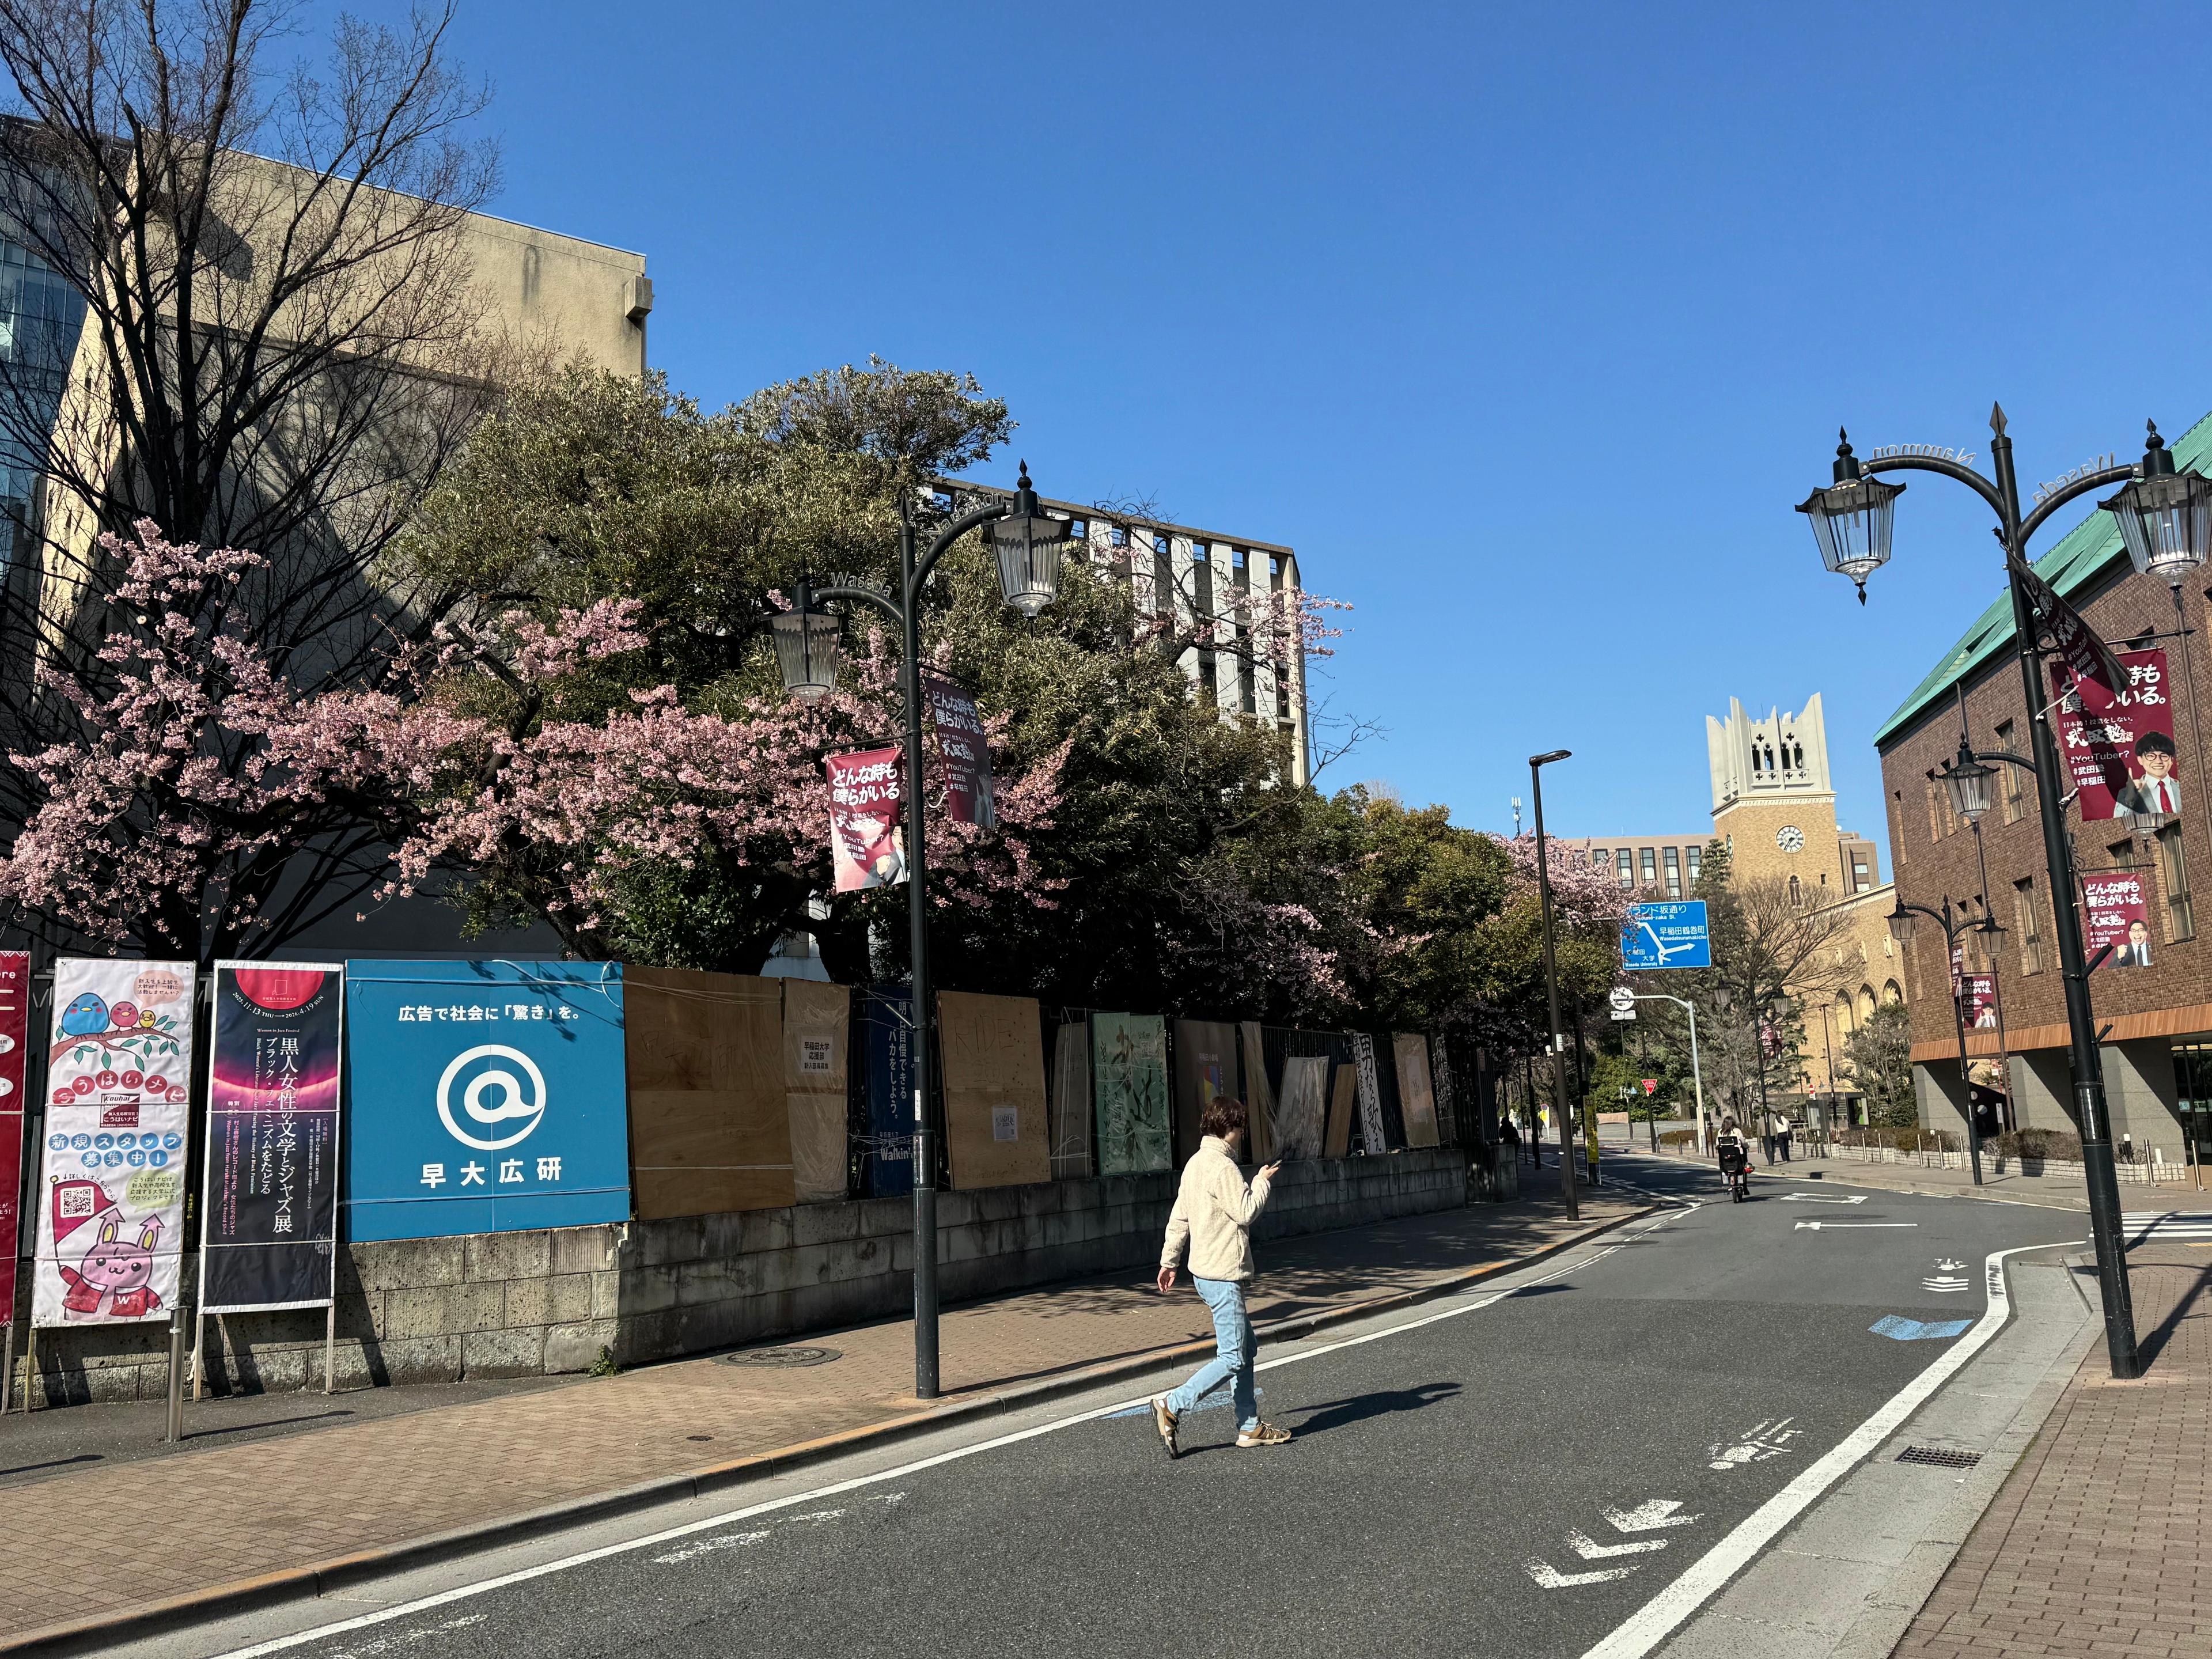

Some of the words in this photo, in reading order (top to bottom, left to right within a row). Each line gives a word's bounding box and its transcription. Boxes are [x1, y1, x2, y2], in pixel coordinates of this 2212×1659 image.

[830, 570, 892, 599] Waseda
[932, 690, 976, 717] どんな時も
[935, 708, 983, 736] 僕らがいる。
[2070, 750, 2130, 764] #YouTuber?
[832, 761, 897, 787] どんな時も
[2085, 881, 2140, 895] どんな時も
[2086, 893, 2143, 907] 僕らがいる。
[1630, 905, 1687, 915] ランド坂通り
[1660, 925, 1705, 935] 早稲田鶴巻町
[315, 995, 324, 1006] SUN
[398, 1005, 579, 1022] 広告で社会に「驚き」を。
[953, 1014, 1014, 1056] RIDE
[804, 1041, 830, 1051] 早稲田大学
[888, 1029, 899, 1119] バカをしよう。
[58, 1073, 185, 1104] こうはいナビ
[260, 1037, 278, 1195] ブラック・フェミニズムをたどる
[51, 1135, 179, 1149] 新規スタッフ
[272, 1037, 299, 1233] 黒人女性の文学とジャズ展
[84, 1151, 160, 1166] 募集中！
[881, 1147, 913, 1161] Walkin'
[420, 1157, 562, 1188] 早大広研
[117, 1296, 130, 1304] W
